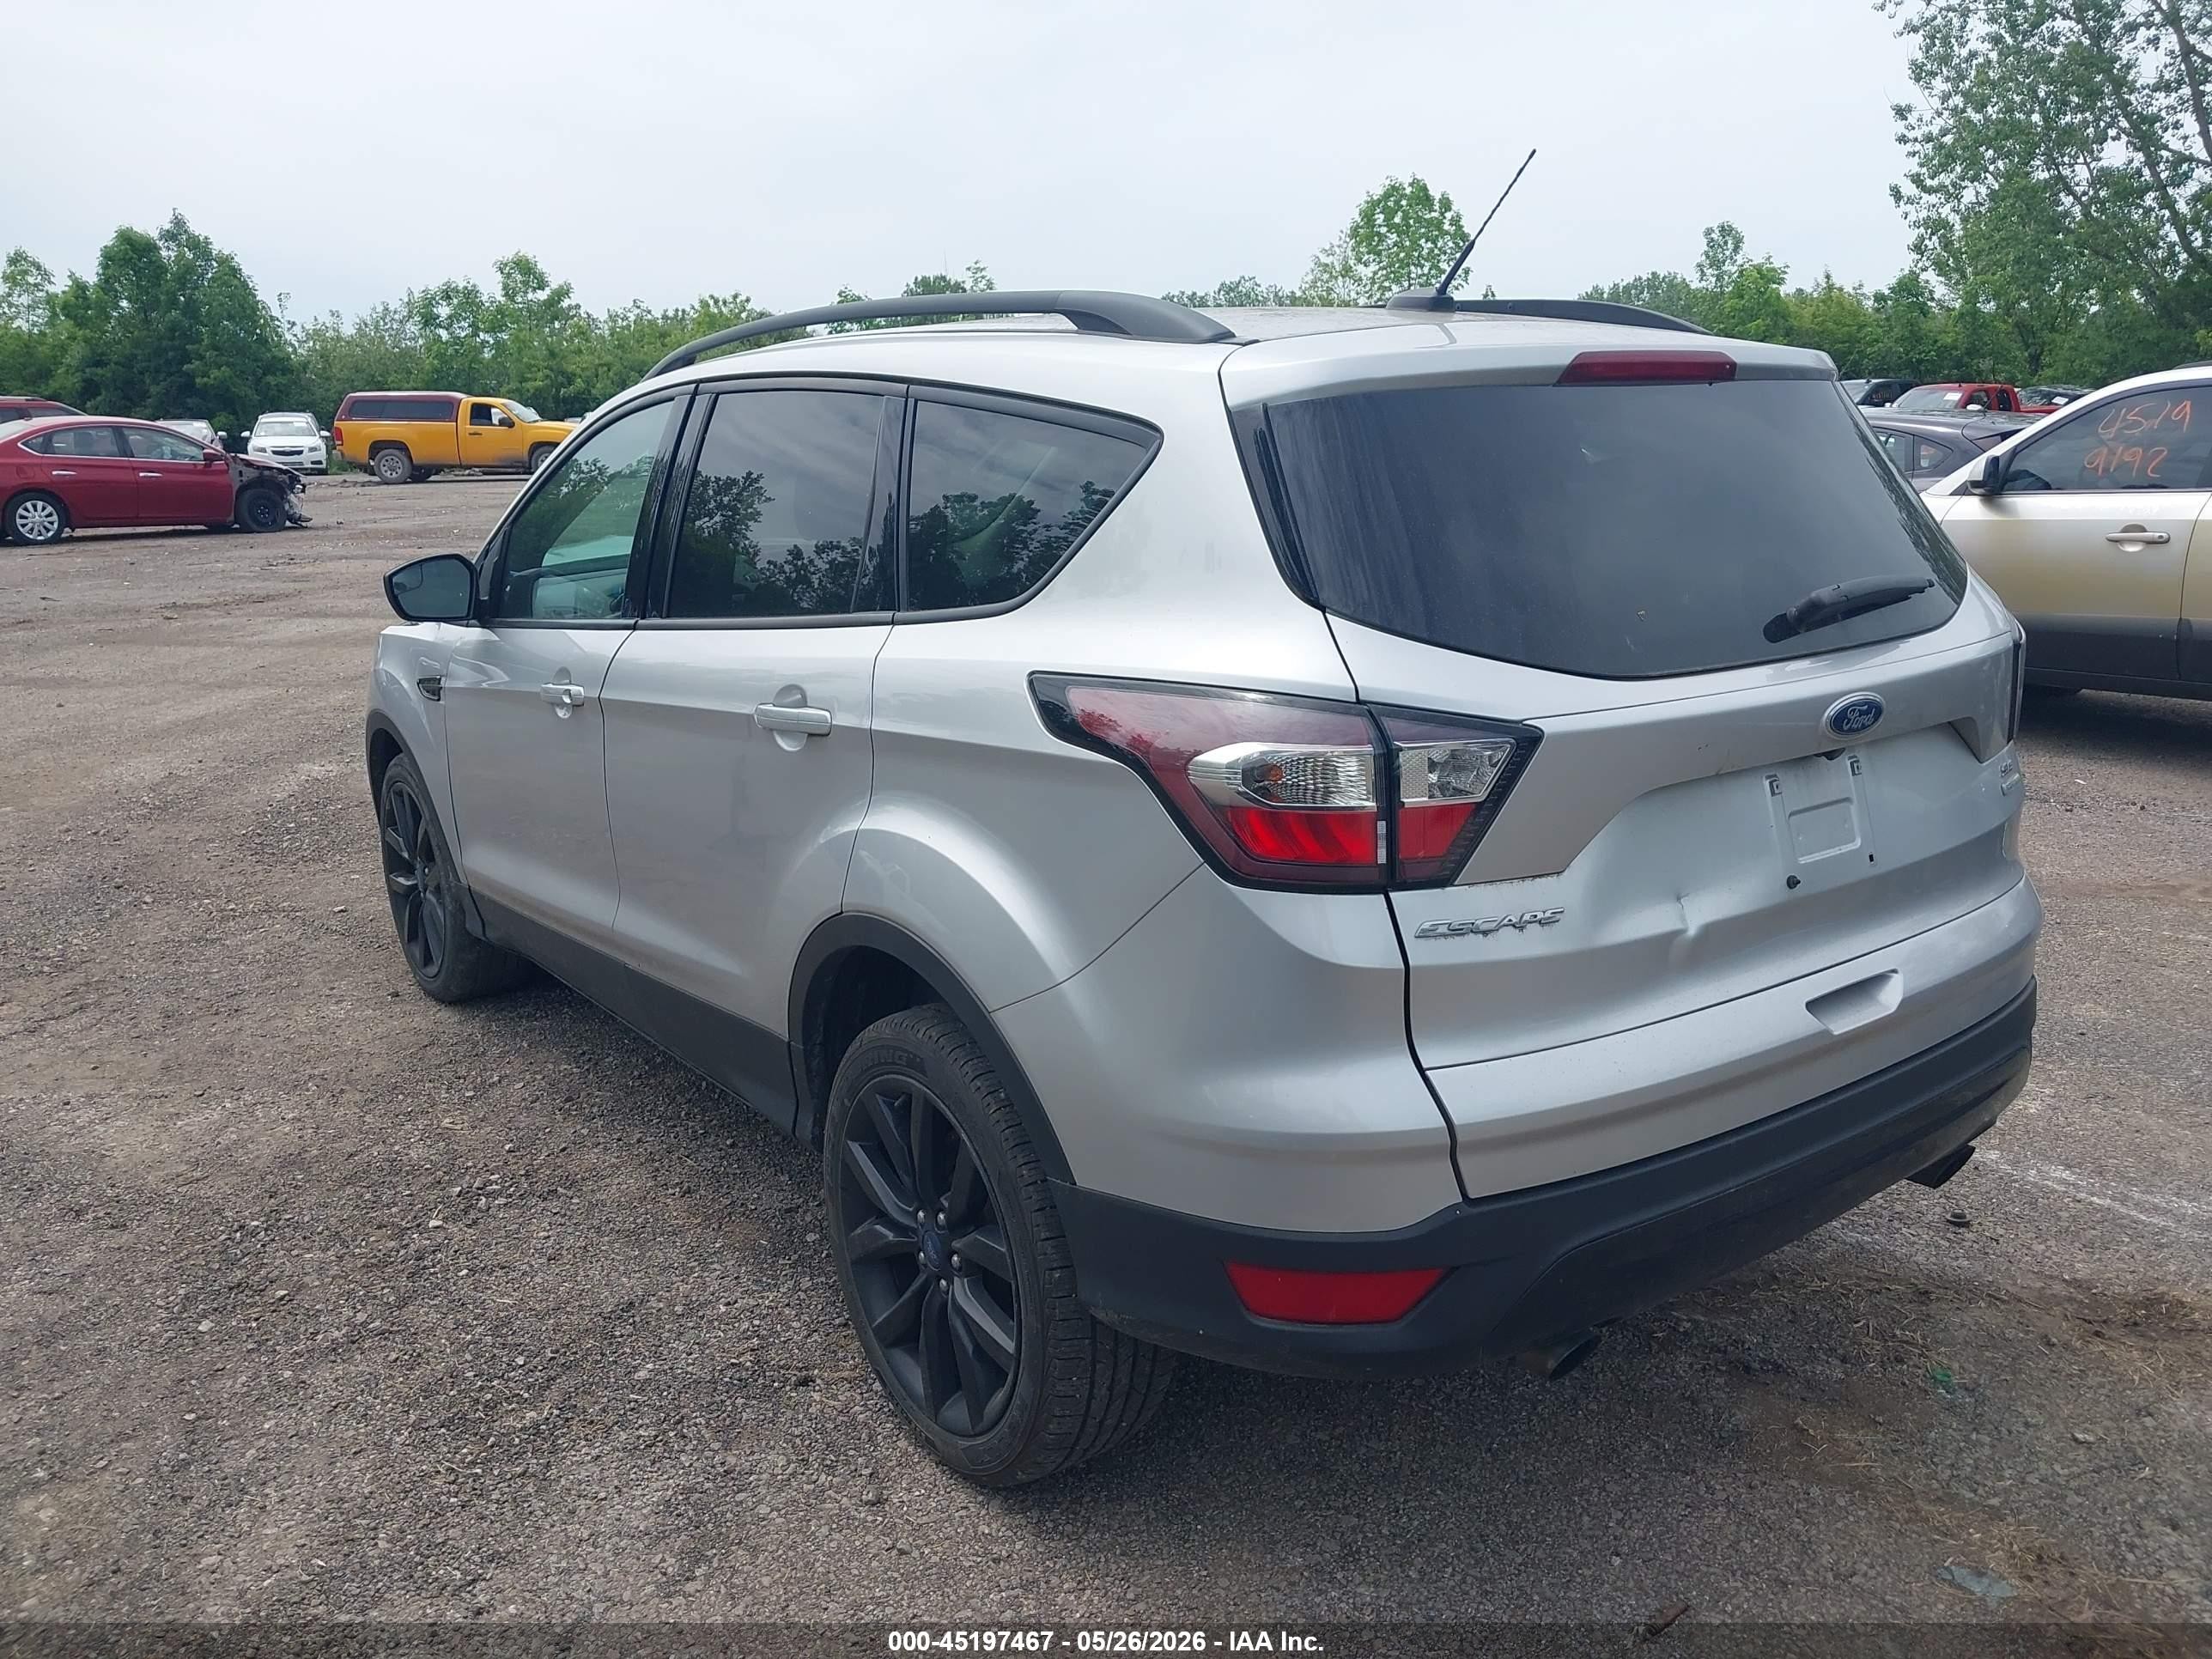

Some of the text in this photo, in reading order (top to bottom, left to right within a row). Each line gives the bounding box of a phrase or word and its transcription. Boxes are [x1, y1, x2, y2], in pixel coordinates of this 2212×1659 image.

[2084, 446, 2168, 477] 9192
[1843, 704, 1875, 730] Ford
[1414, 907, 1565, 939] ESCAPE
